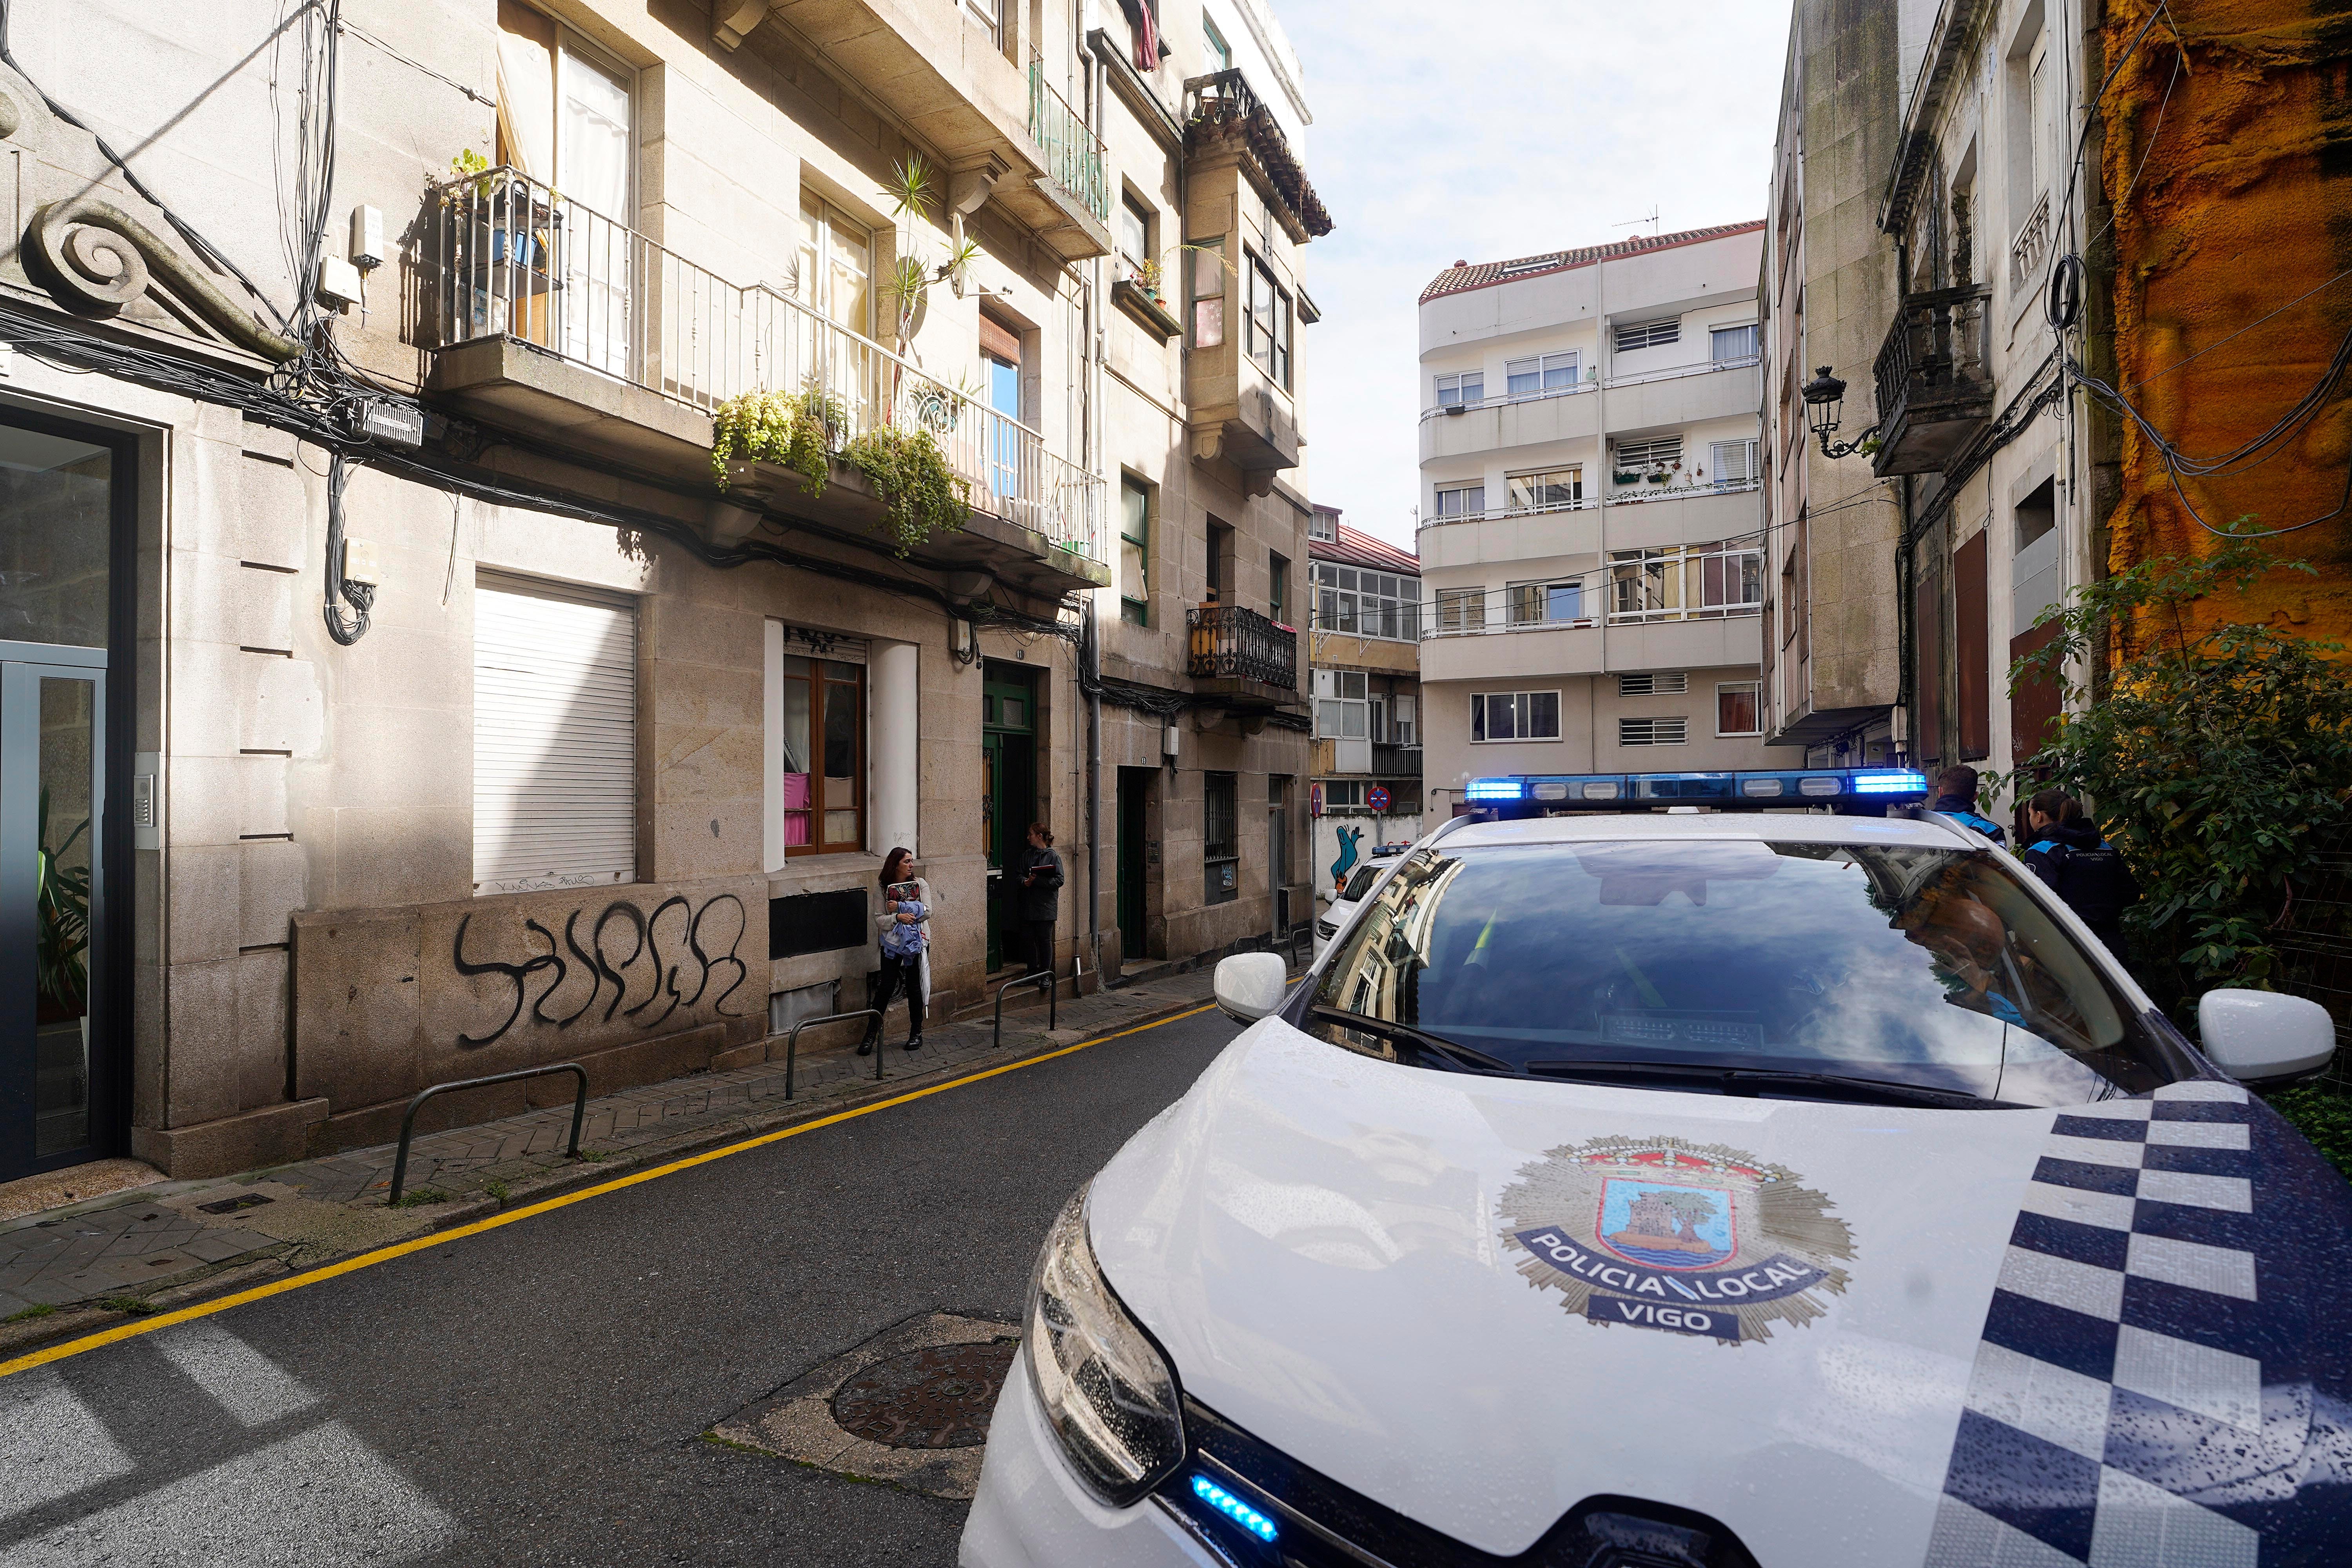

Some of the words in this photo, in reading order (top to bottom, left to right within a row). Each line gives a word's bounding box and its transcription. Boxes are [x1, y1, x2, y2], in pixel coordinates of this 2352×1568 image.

[1017, 650, 1022, 658] 11
[1532, 1232, 1665, 1297] POLICIA
[1695, 1261, 1812, 1299] LOCAL
[1617, 1301, 1711, 1331] VIGO
